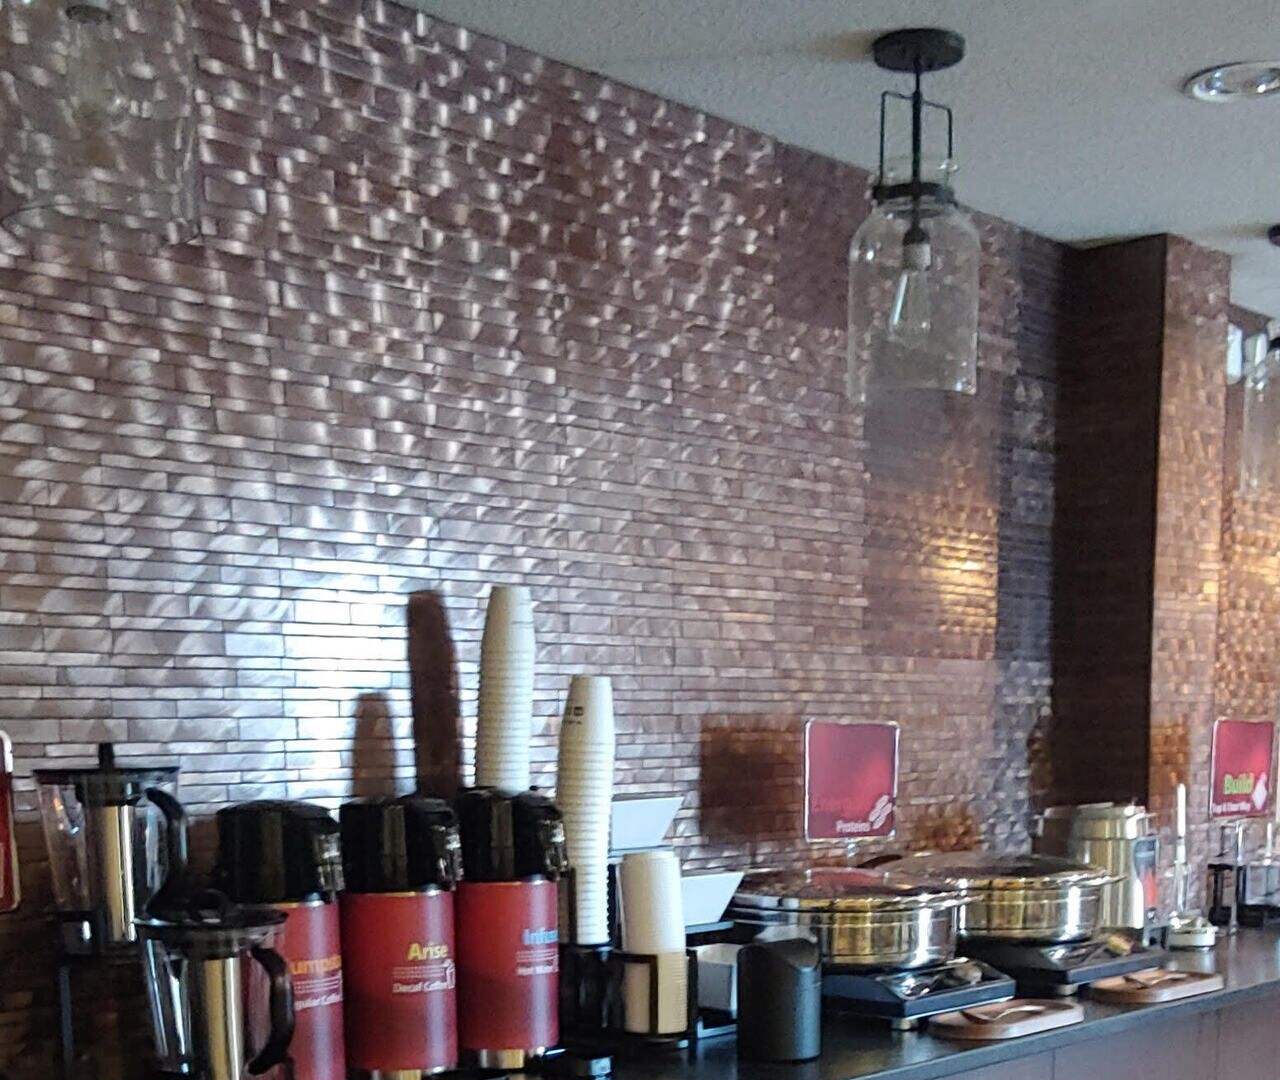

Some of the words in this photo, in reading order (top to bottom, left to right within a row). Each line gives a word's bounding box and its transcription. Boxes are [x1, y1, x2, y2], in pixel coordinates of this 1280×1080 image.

[1223, 773, 1254, 795] Build
[836, 820, 871, 832] Proteins
[407, 942, 448, 961] Arise
